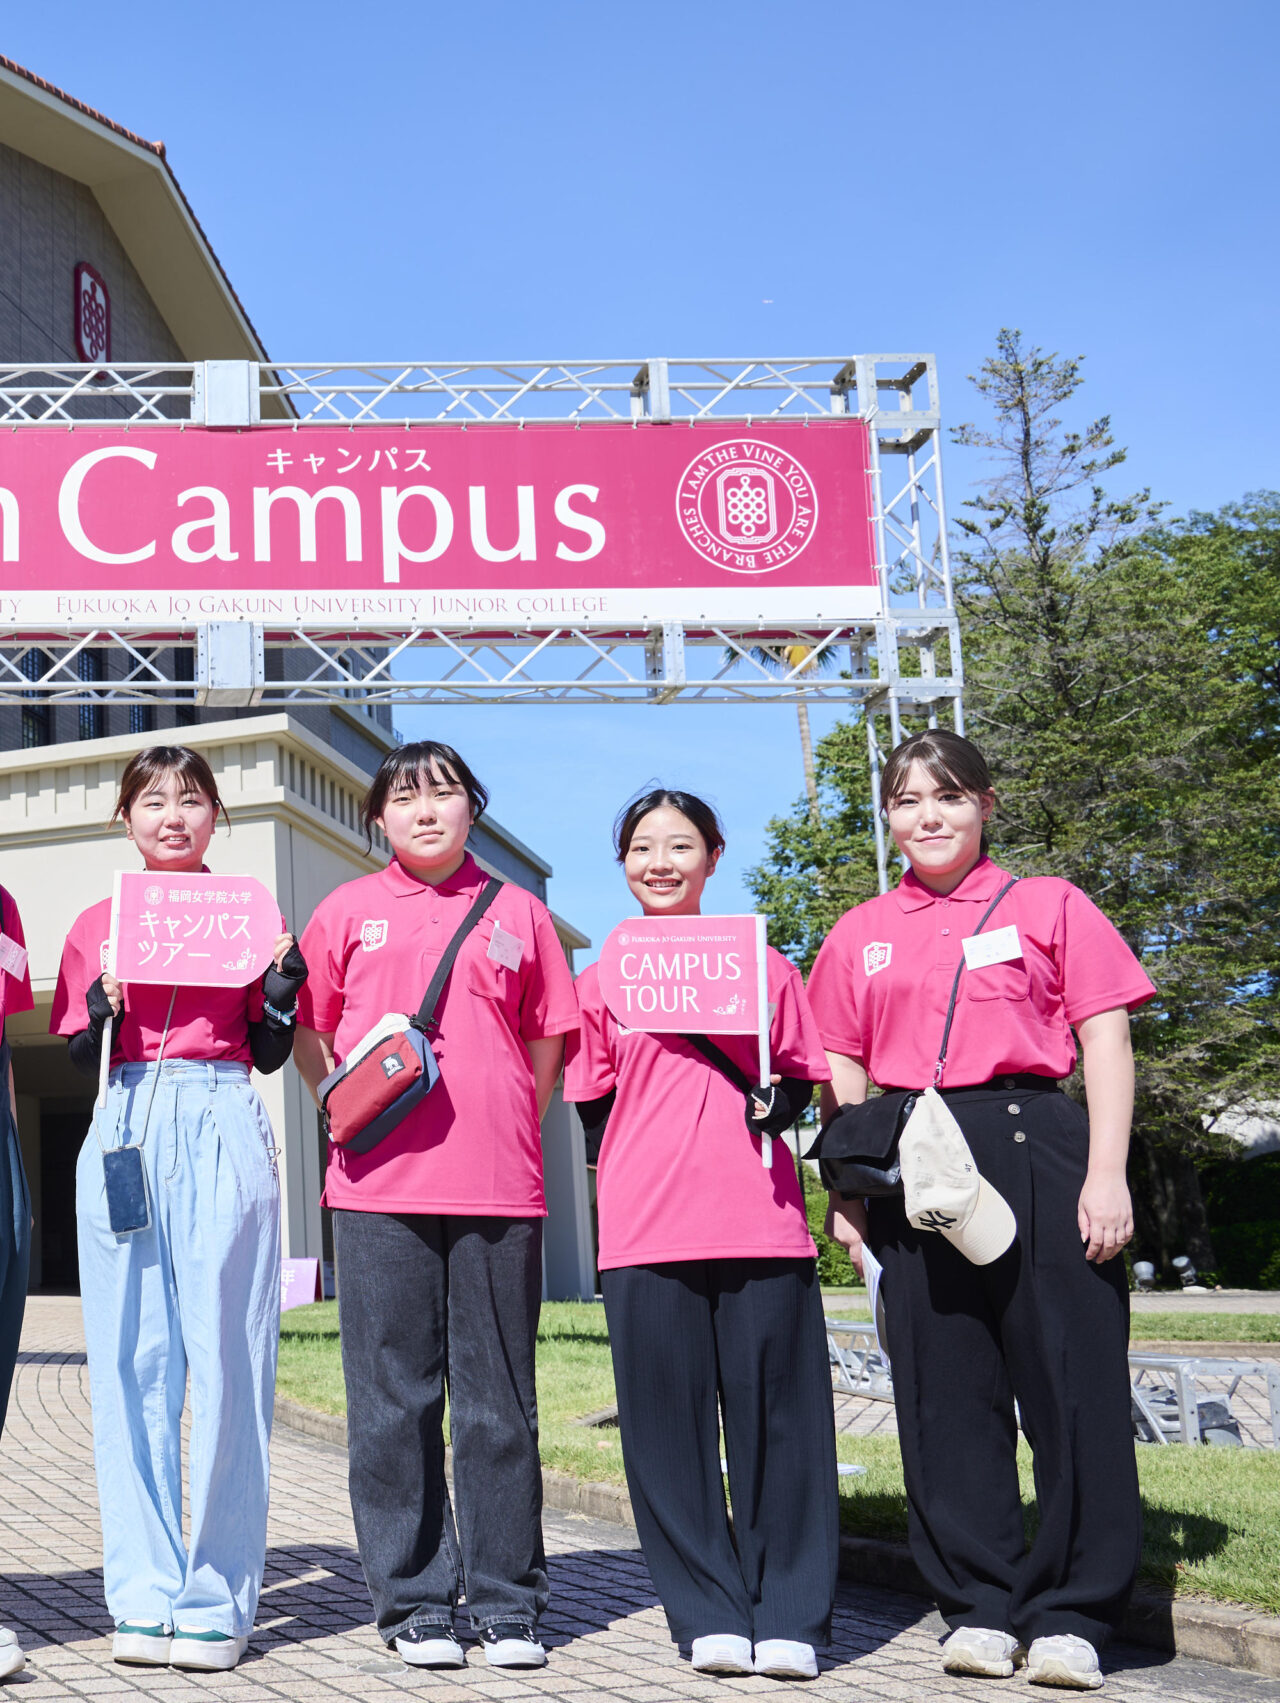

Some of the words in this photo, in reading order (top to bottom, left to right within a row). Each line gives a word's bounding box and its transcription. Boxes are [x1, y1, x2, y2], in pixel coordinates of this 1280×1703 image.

[266, 447, 432, 474] キャンパス
[703, 446, 738, 467] THE
[742, 444, 784, 469] VINE
[688, 464, 709, 490] AM
[785, 464, 809, 499] YOU
[682, 492, 696, 500] I
[57, 445, 606, 584] Campus
[791, 504, 812, 538] ARE
[683, 507, 756, 568] BRANCHES
[763, 540, 797, 564] THE
[57, 596, 158, 613] FUKUOKA
[199, 595, 282, 613] GAKUIN
[294, 596, 422, 613] UNIVERSITY
[432, 595, 508, 615] JUNIOR
[517, 596, 608, 613] COLLEGE
[168, 889, 252, 905] 福岡女学院大学
[139, 910, 252, 941] キャンパス
[137, 940, 211, 967] ツアー
[619, 952, 742, 981] CAMPUS
[619, 985, 701, 1014] TOUR
